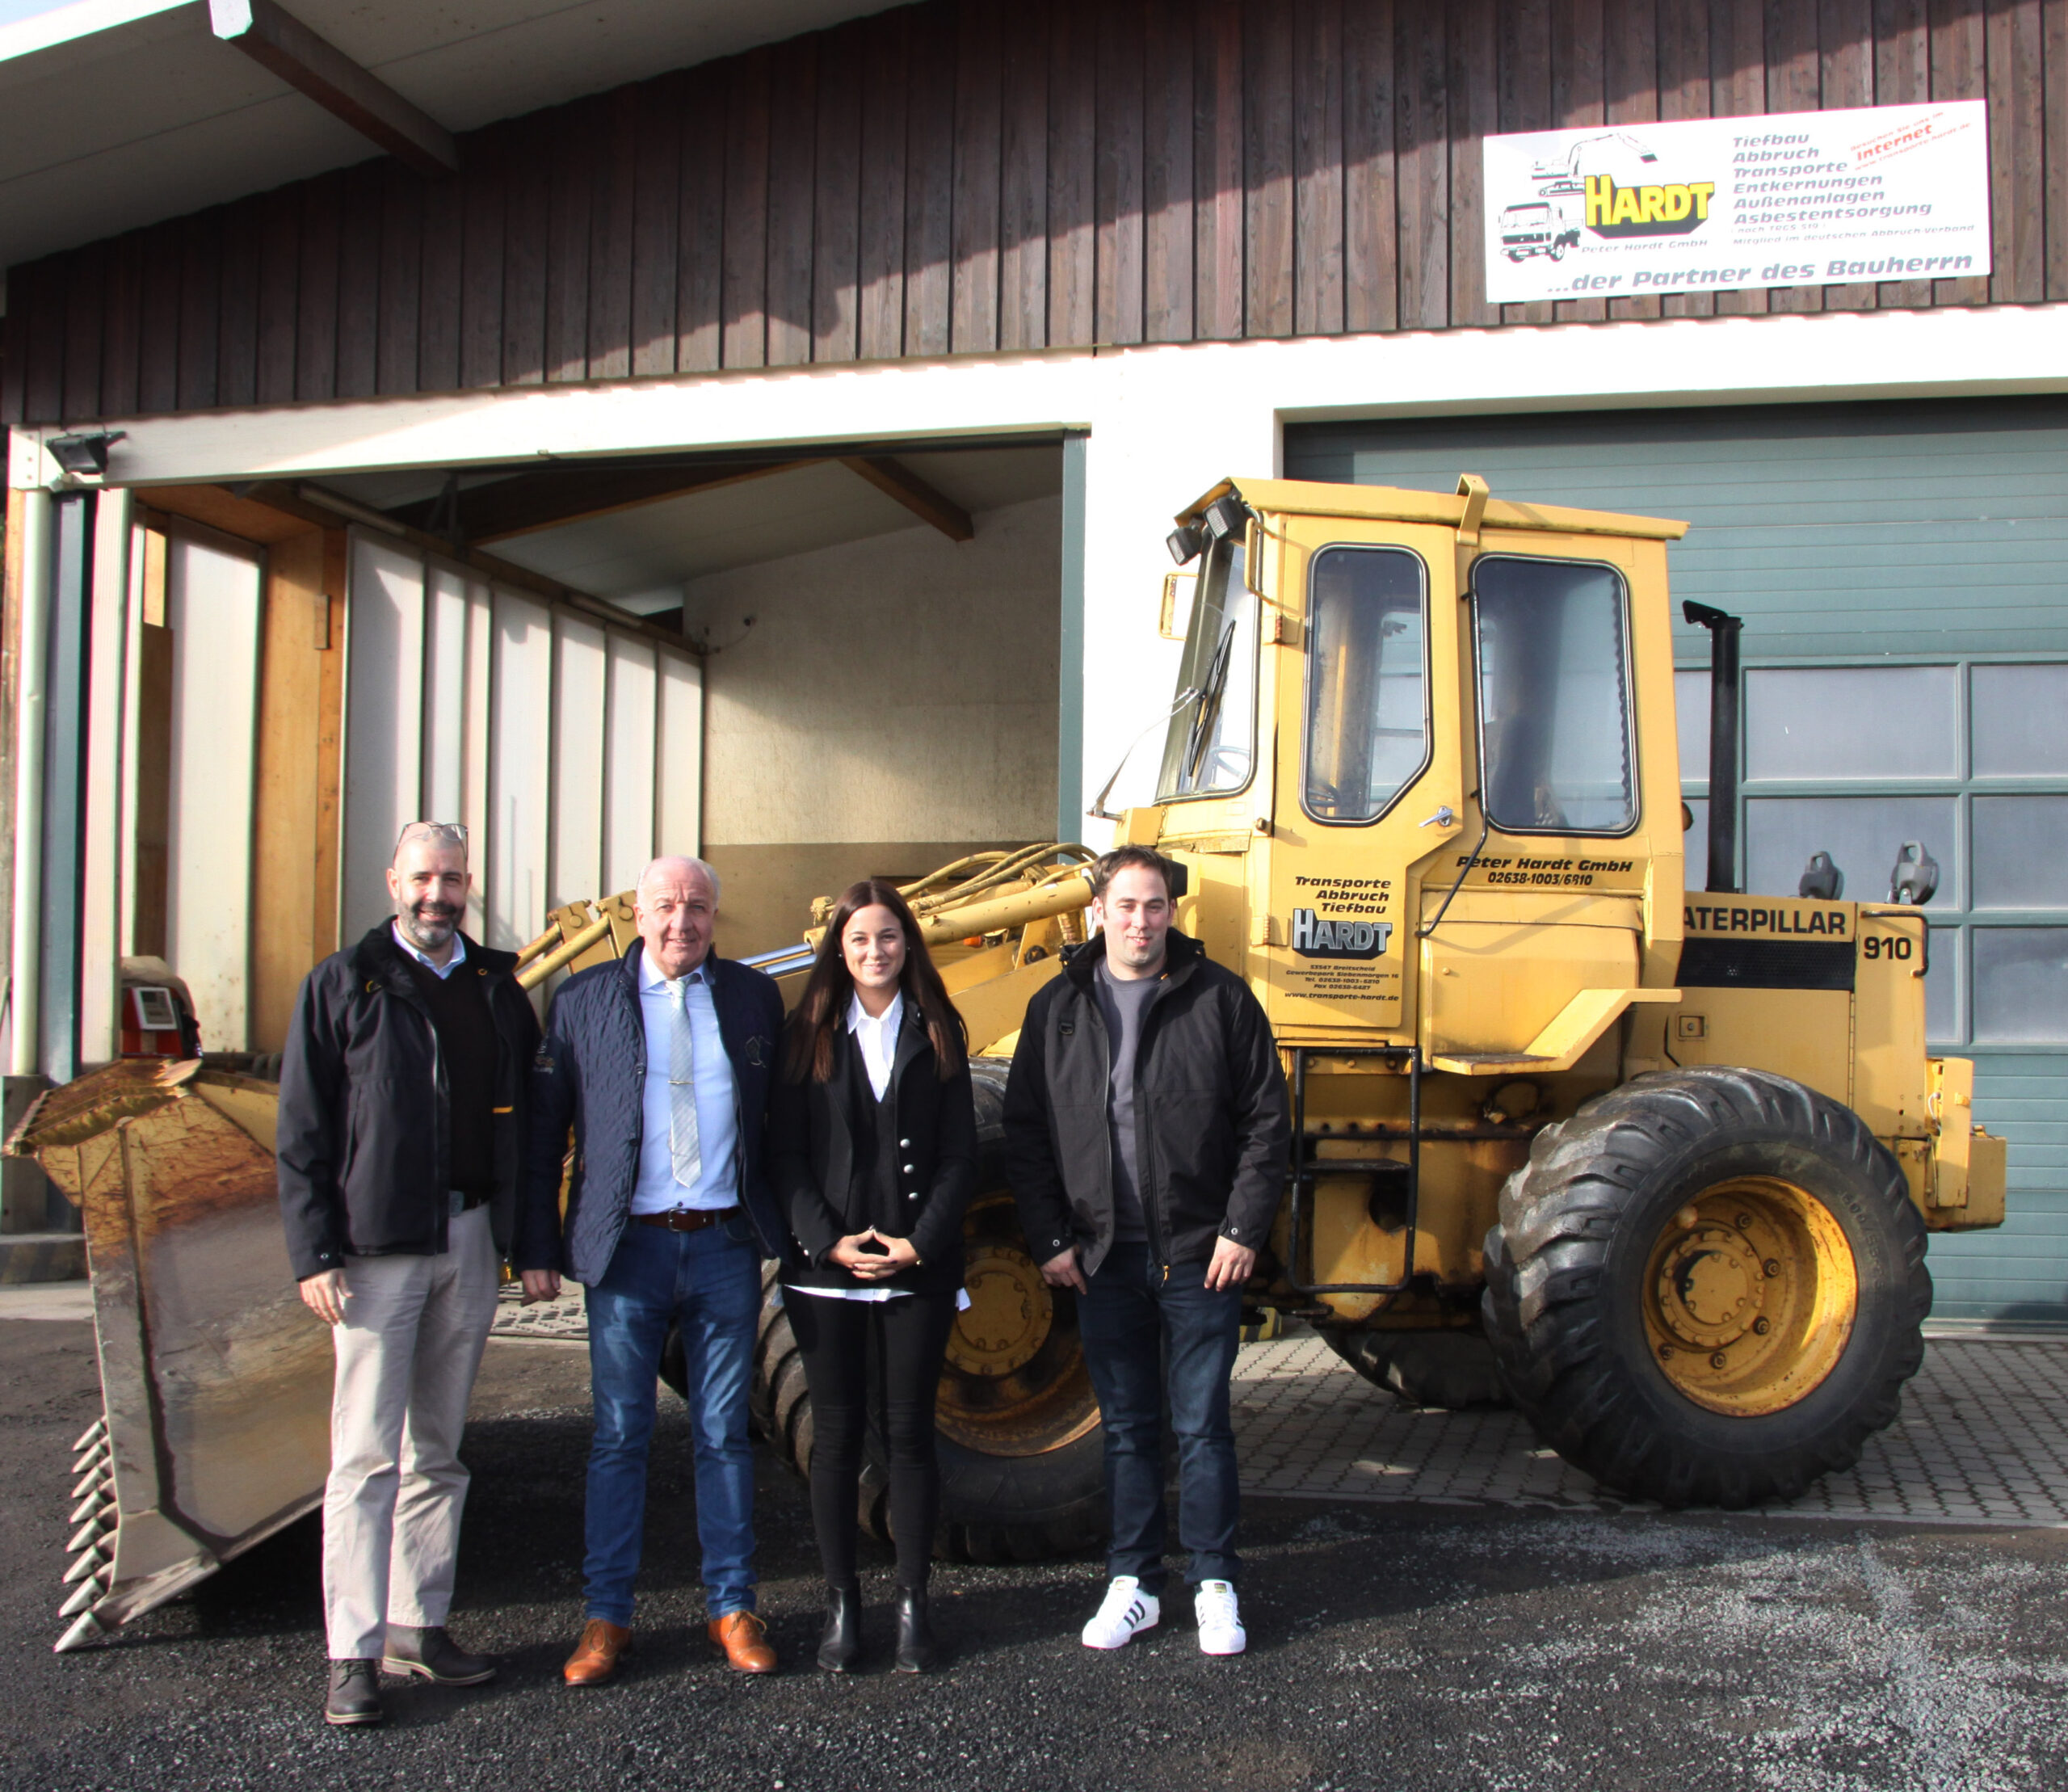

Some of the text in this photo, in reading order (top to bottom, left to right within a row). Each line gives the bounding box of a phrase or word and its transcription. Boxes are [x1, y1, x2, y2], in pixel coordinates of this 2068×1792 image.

[1733, 134, 1810, 148] Tiefbau
[1857, 124, 1932, 161] Internet
[1732, 147, 1819, 163] Abbruch
[1734, 162, 1848, 178] Transporte
[1733, 175, 1883, 194] Entkernungen
[1584, 174, 1715, 228] HARDT
[1733, 191, 1885, 209] Außenanlagen
[1734, 204, 1932, 225] Asbestentsorgung
[1582, 239, 1709, 254] Peter Hardt GmbH
[1733, 236, 1781, 245] Mitglied
[1547, 255, 1973, 293] ...der Partner des Bauherrn
[1456, 856, 1633, 872] Peter Hardt GmbH
[1295, 876, 1391, 889] Transporte
[1315, 890, 1389, 902] Abbruch
[1322, 902, 1387, 914] Tiefbau
[1683, 906, 1846, 935] ATERPILLAR
[1292, 908, 1393, 952] HARDT
[1864, 936, 1912, 960] 910
[1284, 992, 1399, 1001] www.transporte-hardt.de
